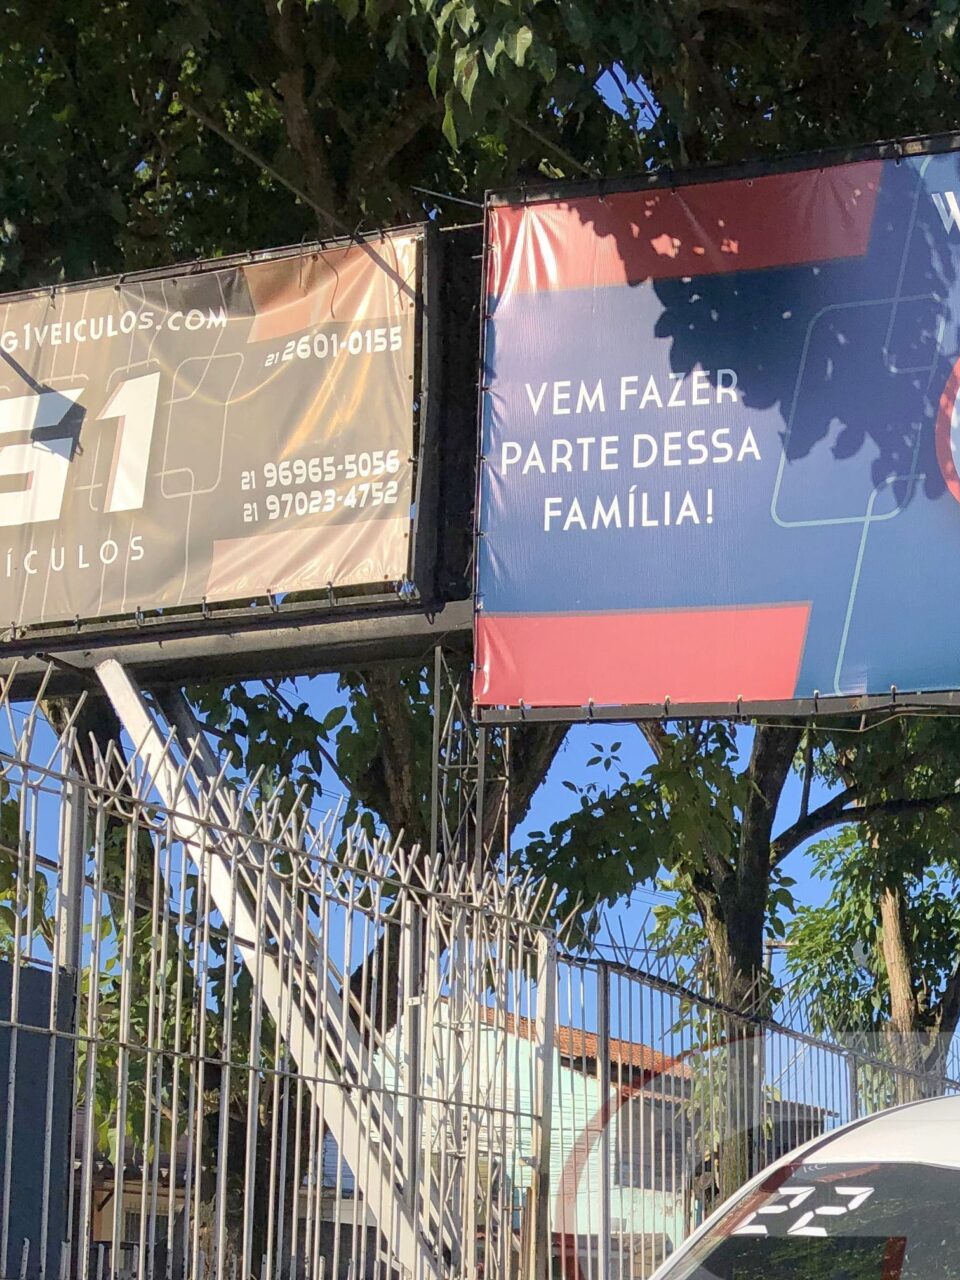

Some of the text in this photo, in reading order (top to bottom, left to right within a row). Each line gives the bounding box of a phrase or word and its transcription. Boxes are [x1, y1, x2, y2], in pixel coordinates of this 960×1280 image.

[265, 326, 402, 367] 21 2601-0155
[524, 368, 738, 416] VEM FAZER
[241, 450, 400, 490] 21 96965-5056
[501, 427, 762, 475] PARTE DESSA
[243, 481, 399, 522] 21 97023-4752
[543, 485, 714, 532] FAMÍLIA!
